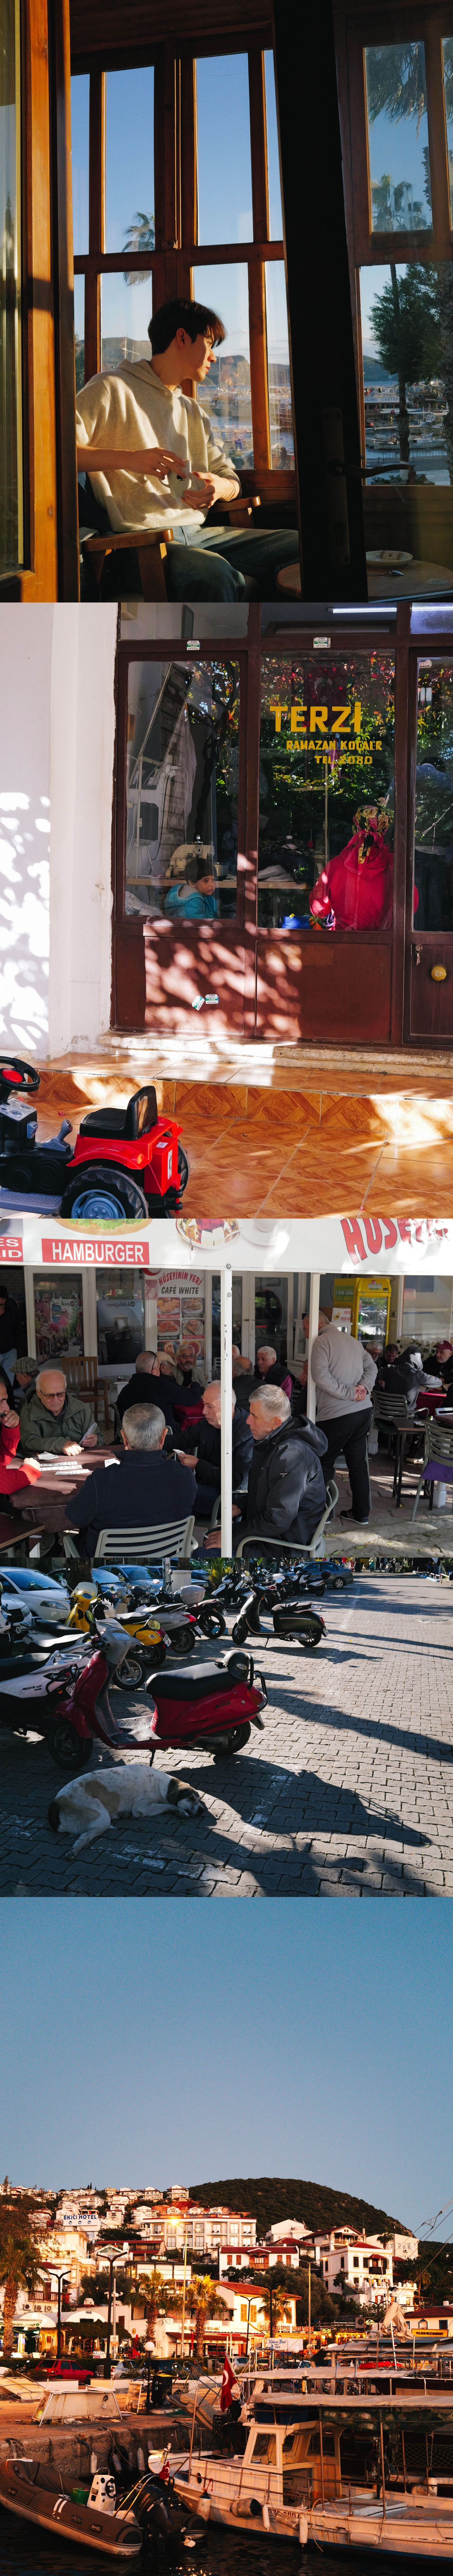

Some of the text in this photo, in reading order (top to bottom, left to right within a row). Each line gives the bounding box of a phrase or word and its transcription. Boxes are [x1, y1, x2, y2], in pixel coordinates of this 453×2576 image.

[270, 702, 361, 732] TERZİ
[286, 740, 336, 750] RAMAZAN
[52, 1242, 145, 1262] HAMBURGER
[159, 1270, 203, 1286] HÜSEYİNİN YERİ
[161, 1285, 177, 1294] CAFÉ
[141, 2493, 151, 2504] YAMAHA
